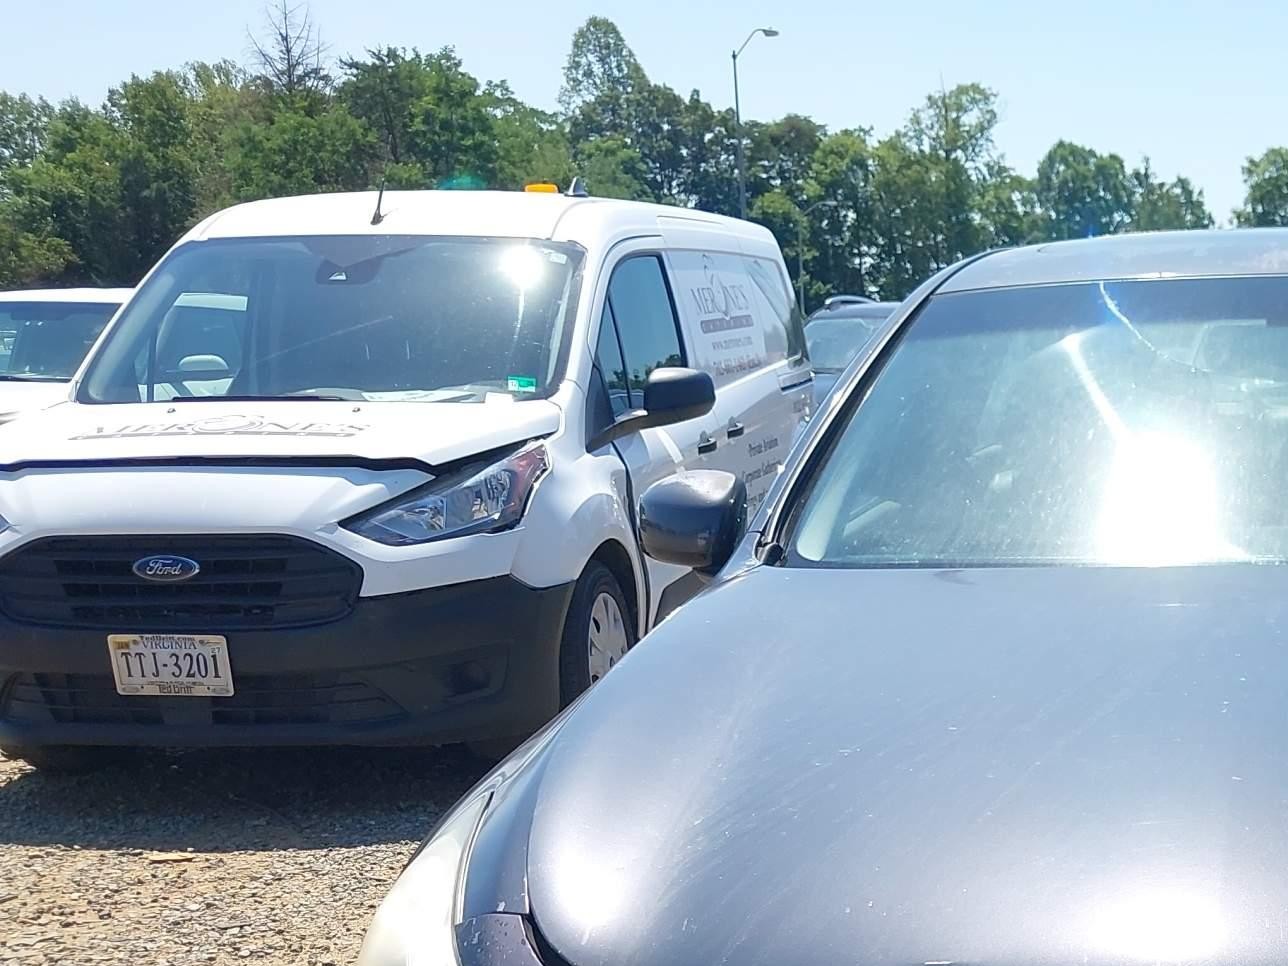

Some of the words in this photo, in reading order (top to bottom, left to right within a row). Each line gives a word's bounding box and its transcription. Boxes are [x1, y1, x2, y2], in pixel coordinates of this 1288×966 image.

[146, 559, 182, 575] Ford
[143, 640, 197, 650] VIRGINIA
[121, 652, 222, 679] TTJ-3201
